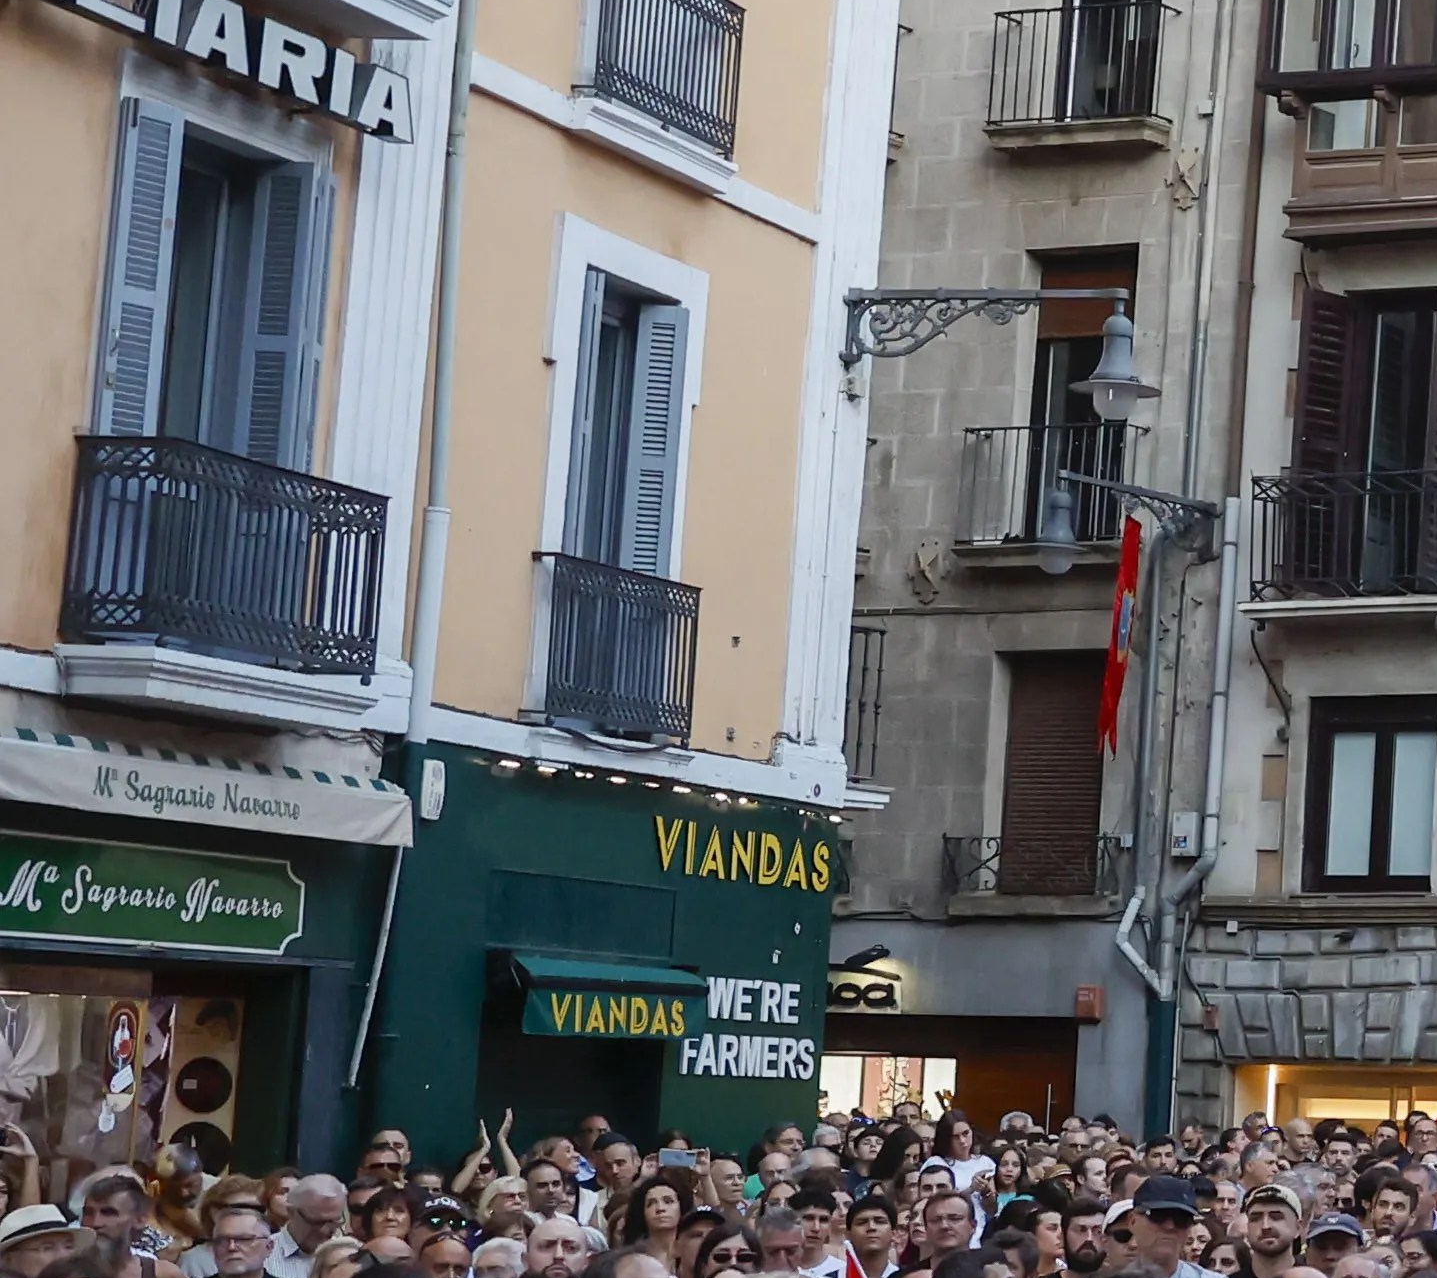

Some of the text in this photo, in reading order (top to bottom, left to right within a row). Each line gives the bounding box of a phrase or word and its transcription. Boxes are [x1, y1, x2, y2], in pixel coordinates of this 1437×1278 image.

[124, 769, 215, 815] Sagrario
[223, 782, 301, 821] Navarro
[654, 814, 831, 893] VIANDAS
[61, 864, 178, 915] Sagrario
[180, 877, 284, 924] Navarro
[550, 992, 686, 1038] VIANDAS
[679, 1032, 815, 1082] FARMERS
